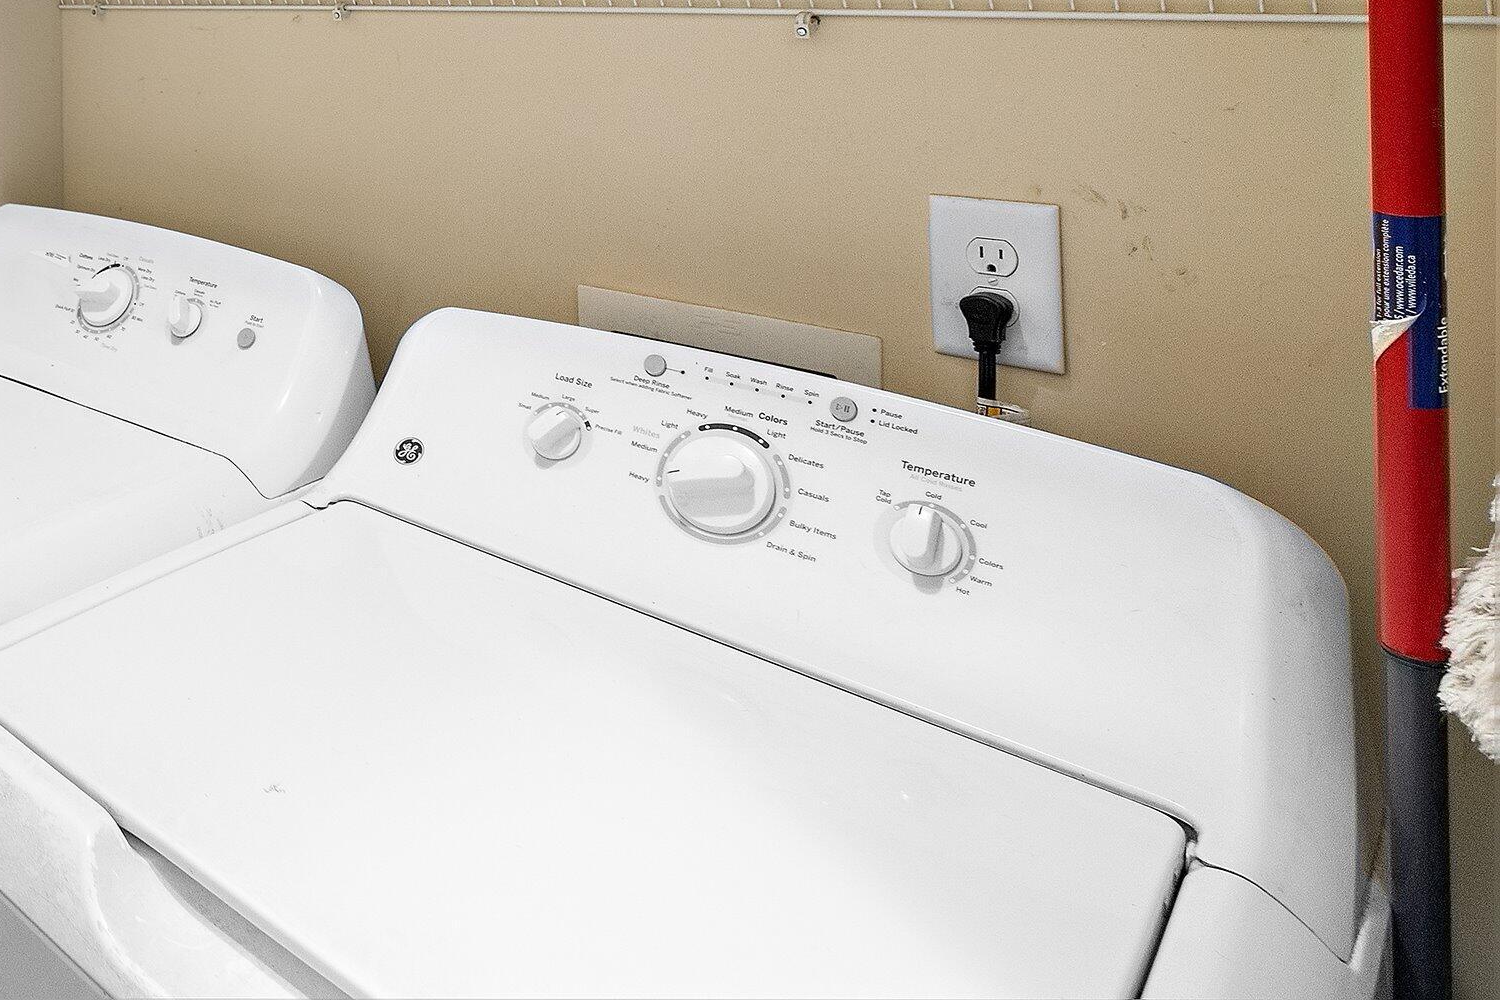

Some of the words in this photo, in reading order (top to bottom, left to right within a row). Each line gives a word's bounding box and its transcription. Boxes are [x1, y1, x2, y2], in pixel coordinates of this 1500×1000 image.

[188, 276, 218, 289] Temperature
[1382, 302, 1391, 317] pour
[249, 314, 264, 324] Start
[1438, 316, 1449, 394] Extendable
[555, 372, 575, 384] Load
[576, 377, 593, 389] Size
[725, 371, 741, 380] Soak
[750, 376, 768, 386] Wash
[633, 375, 652, 386] Deep
[652, 379, 670, 390] Rinse
[775, 382, 794, 392] Rinse
[531, 391, 550, 400] Medium
[562, 394, 575, 402] Large
[804, 388, 820, 398] Spin
[686, 408, 708, 420] Heavy
[724, 405, 754, 418] Medium
[880, 408, 902, 420] Pause
[661, 419, 679, 430] Light
[758, 411, 788, 426] Colors
[632, 425, 661, 439] Whites
[815, 419, 865, 438] Start/Pause
[878, 419, 891, 429] Lid
[891, 421, 918, 435] Locked
[766, 428, 786, 440] Light
[630, 440, 658, 453] Medium
[788, 453, 824, 469] Delicates
[629, 471, 650, 484] Heavy
[901, 459, 976, 488] Temperature
[798, 487, 830, 503] Casuals
[875, 495, 892, 505] Cold
[879, 489, 891, 498] Tap
[925, 491, 942, 501] Cold
[789, 519, 812, 534] Bulky
[813, 526, 837, 540] Items
[970, 519, 988, 529] Cool
[766, 541, 788, 553] Drain
[798, 549, 817, 563] Spin
[978, 557, 1004, 570] Colors
[970, 575, 993, 588] Warm
[956, 586, 970, 596] Hot
